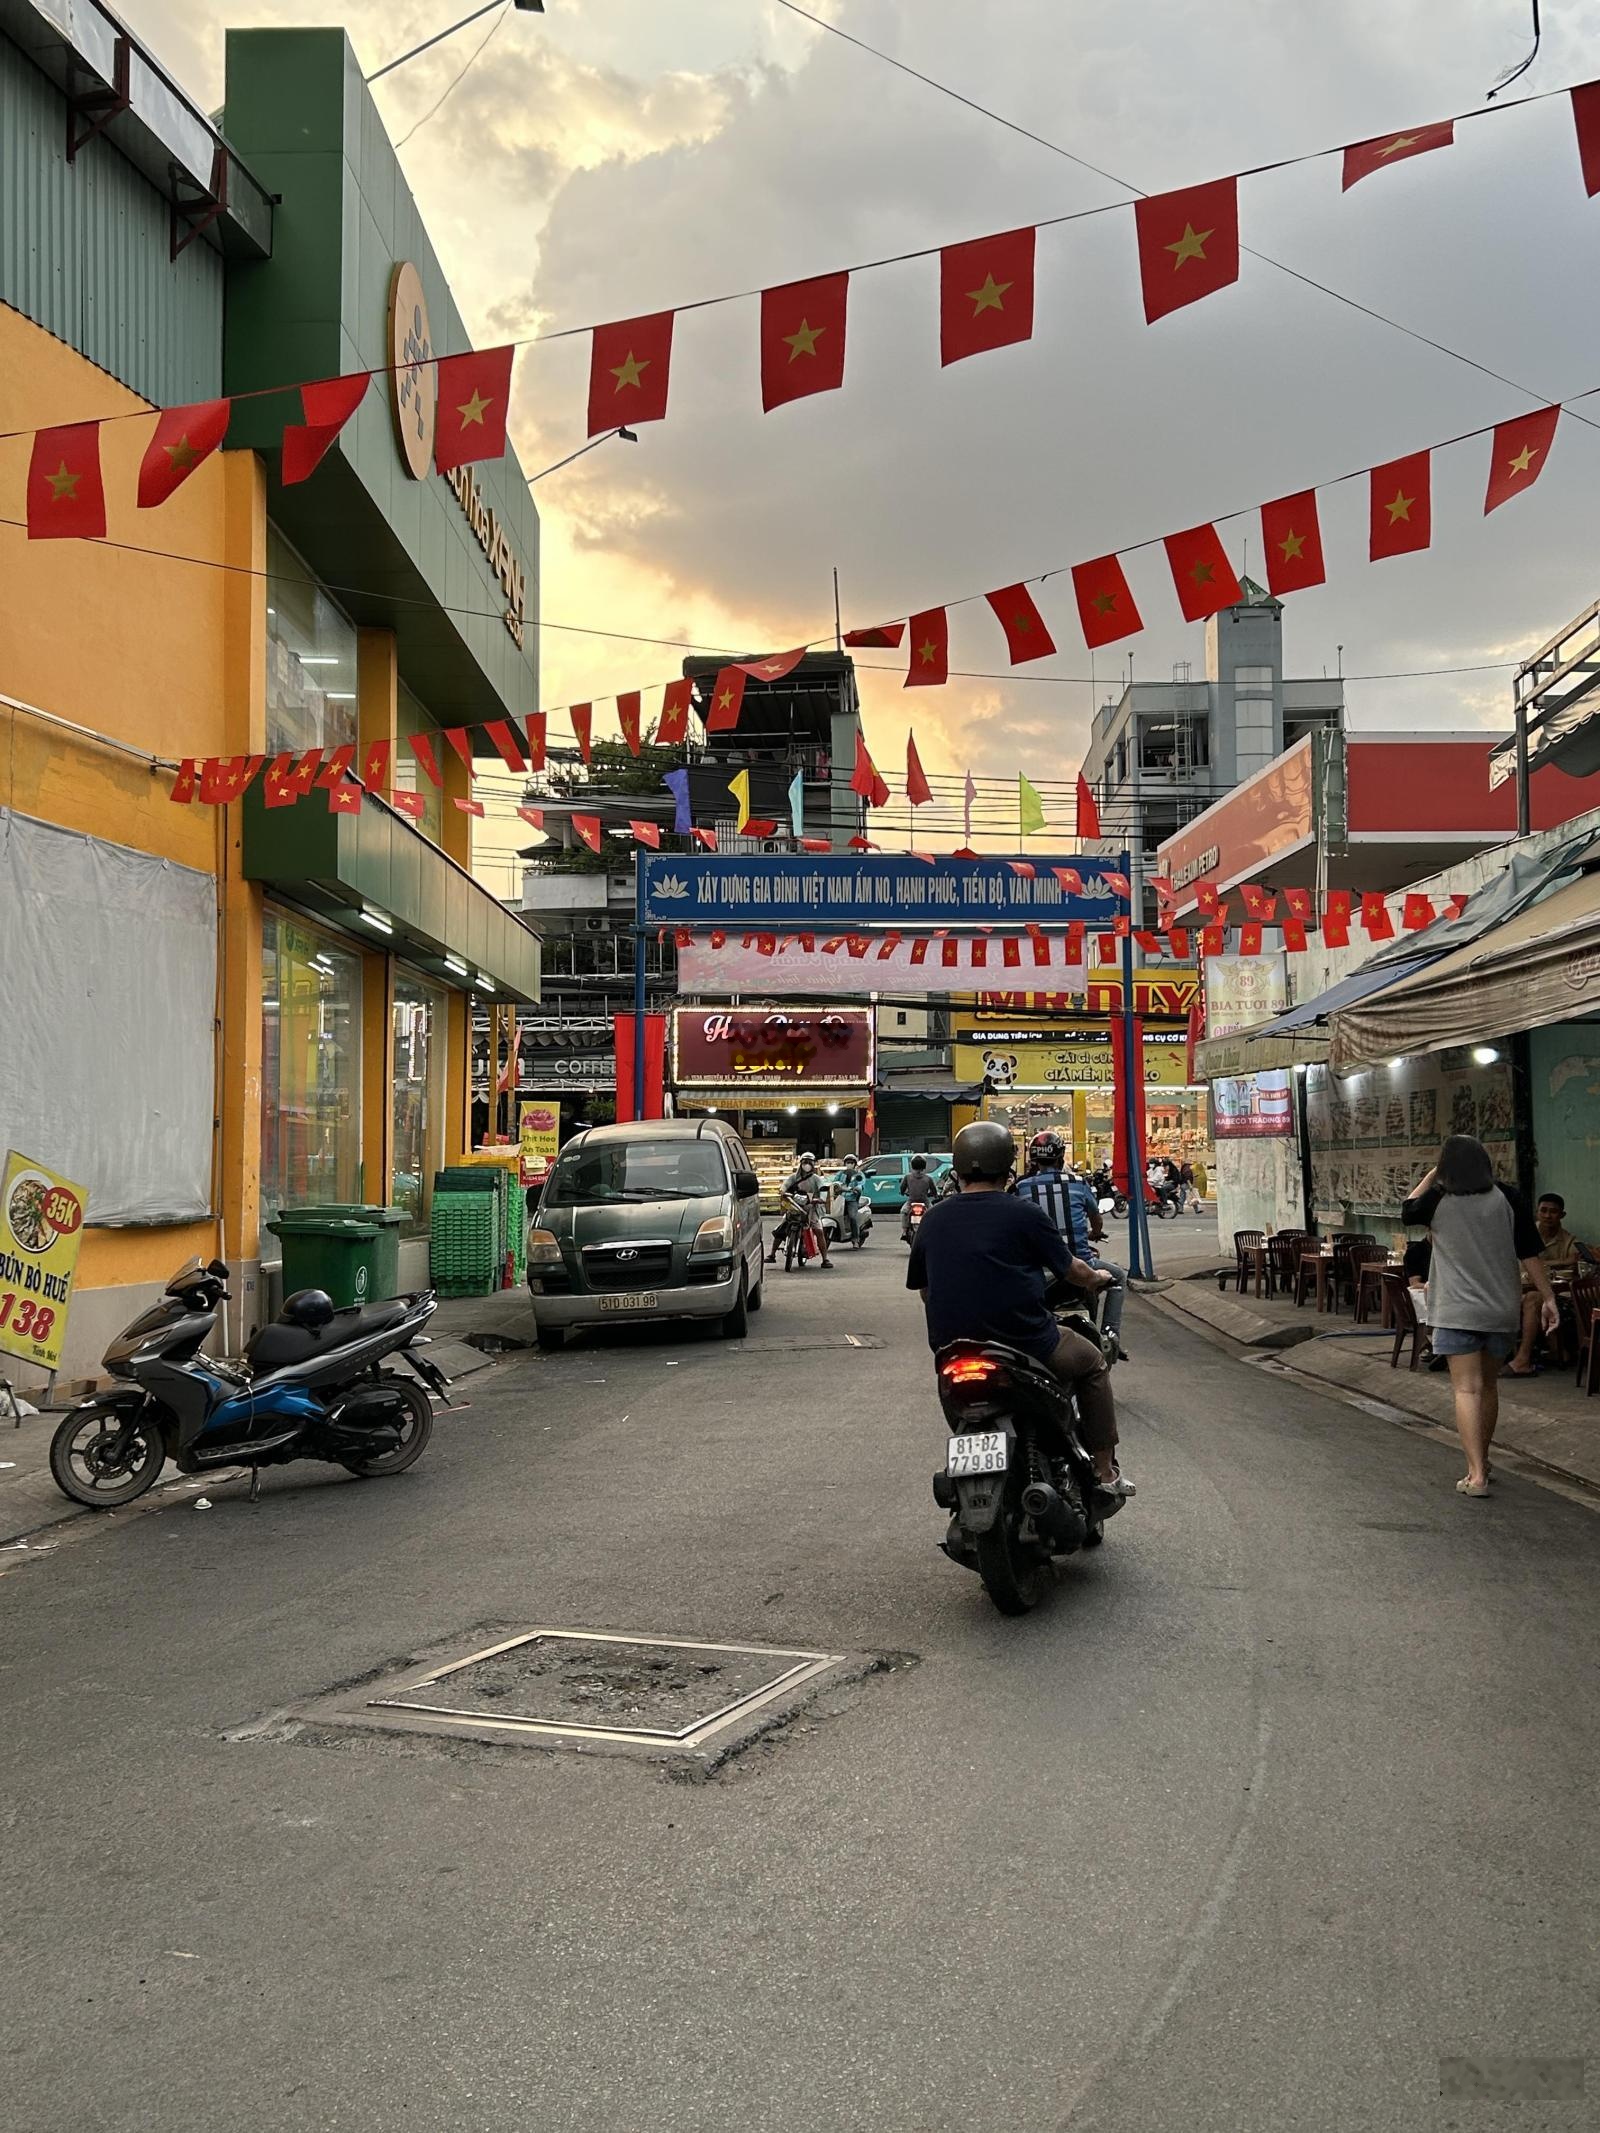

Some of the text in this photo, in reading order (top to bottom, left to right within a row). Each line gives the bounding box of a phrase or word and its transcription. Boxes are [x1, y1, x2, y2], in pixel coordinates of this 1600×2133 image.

[1199, 845, 1219, 877] PETRO
[698, 871, 718, 903] XÂY
[721, 874, 750, 909] DỰNG
[753, 876, 771, 903] GIA
[774, 870, 799, 903] ĐÌNH
[802, 871, 825, 910] VIỆT
[828, 876, 852, 903] NAM
[855, 866, 872, 903] ẤM
[875, 876, 893, 907] NO,
[896, 876, 925, 910] HẠNH
[928, 871, 959, 907] PHÚC,
[963, 867, 986, 904] TIẾN
[989, 871, 1006, 910] BỘ,
[1034, 877, 1062, 904] MINH
[1240, 975, 1255, 987] 89
[1211, 1001, 1232, 1011] BIA
[1271, 999, 1285, 1010] 89
[1092, 1052, 1115, 1064] CŨN
[1215, 1117, 1247, 1125] HABECO
[1248, 1115, 1281, 1124] TRADING
[46, 1191, 78, 1229] 35K
[0, 1250, 71, 1305] BÚN BÒ HUẾ
[0, 1291, 55, 1343] 138
[956, 1434, 999, 1455] 81-B2
